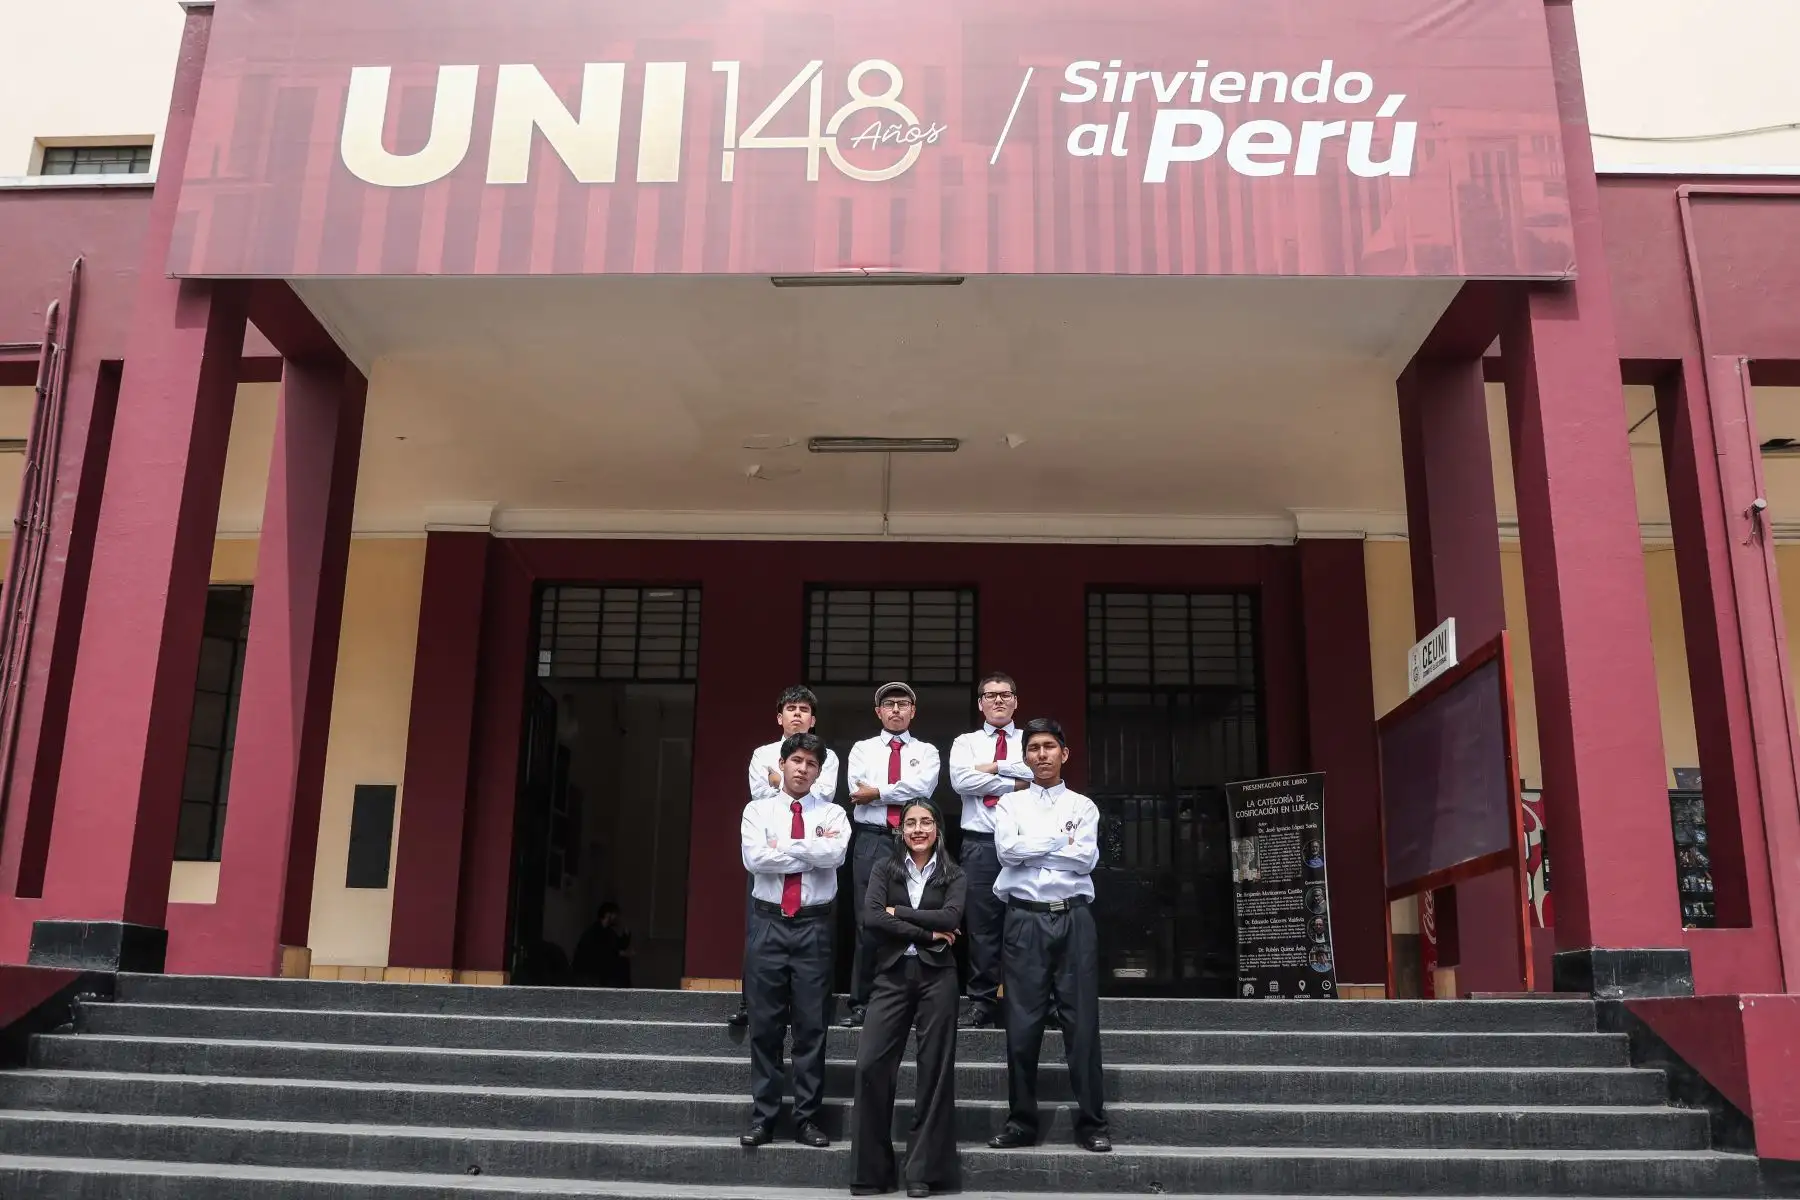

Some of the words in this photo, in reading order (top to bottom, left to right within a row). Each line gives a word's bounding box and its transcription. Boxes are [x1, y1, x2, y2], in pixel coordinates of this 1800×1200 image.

[1060, 59, 1374, 105] Sirviendo
[340, 61, 687, 187] UNI
[711, 58, 923, 182] 148
[850, 120, 948, 151] Años
[1066, 111, 1129, 158] al
[1143, 93, 1418, 184] Perú
[1422, 629, 1447, 669] CEUNI
[1242, 781, 1281, 791] PRESENTACIÓN
[1291, 778, 1307, 786] LIBRO
[1246, 800, 1255, 808] LA
[1257, 794, 1294, 807] CATEGORÍA
[1296, 794, 1305, 802] DE
[1235, 805, 1279, 819] COSIFICACIÓN
[1281, 805, 1290, 813] EN
[1292, 802, 1319, 812] LUKÁCS
